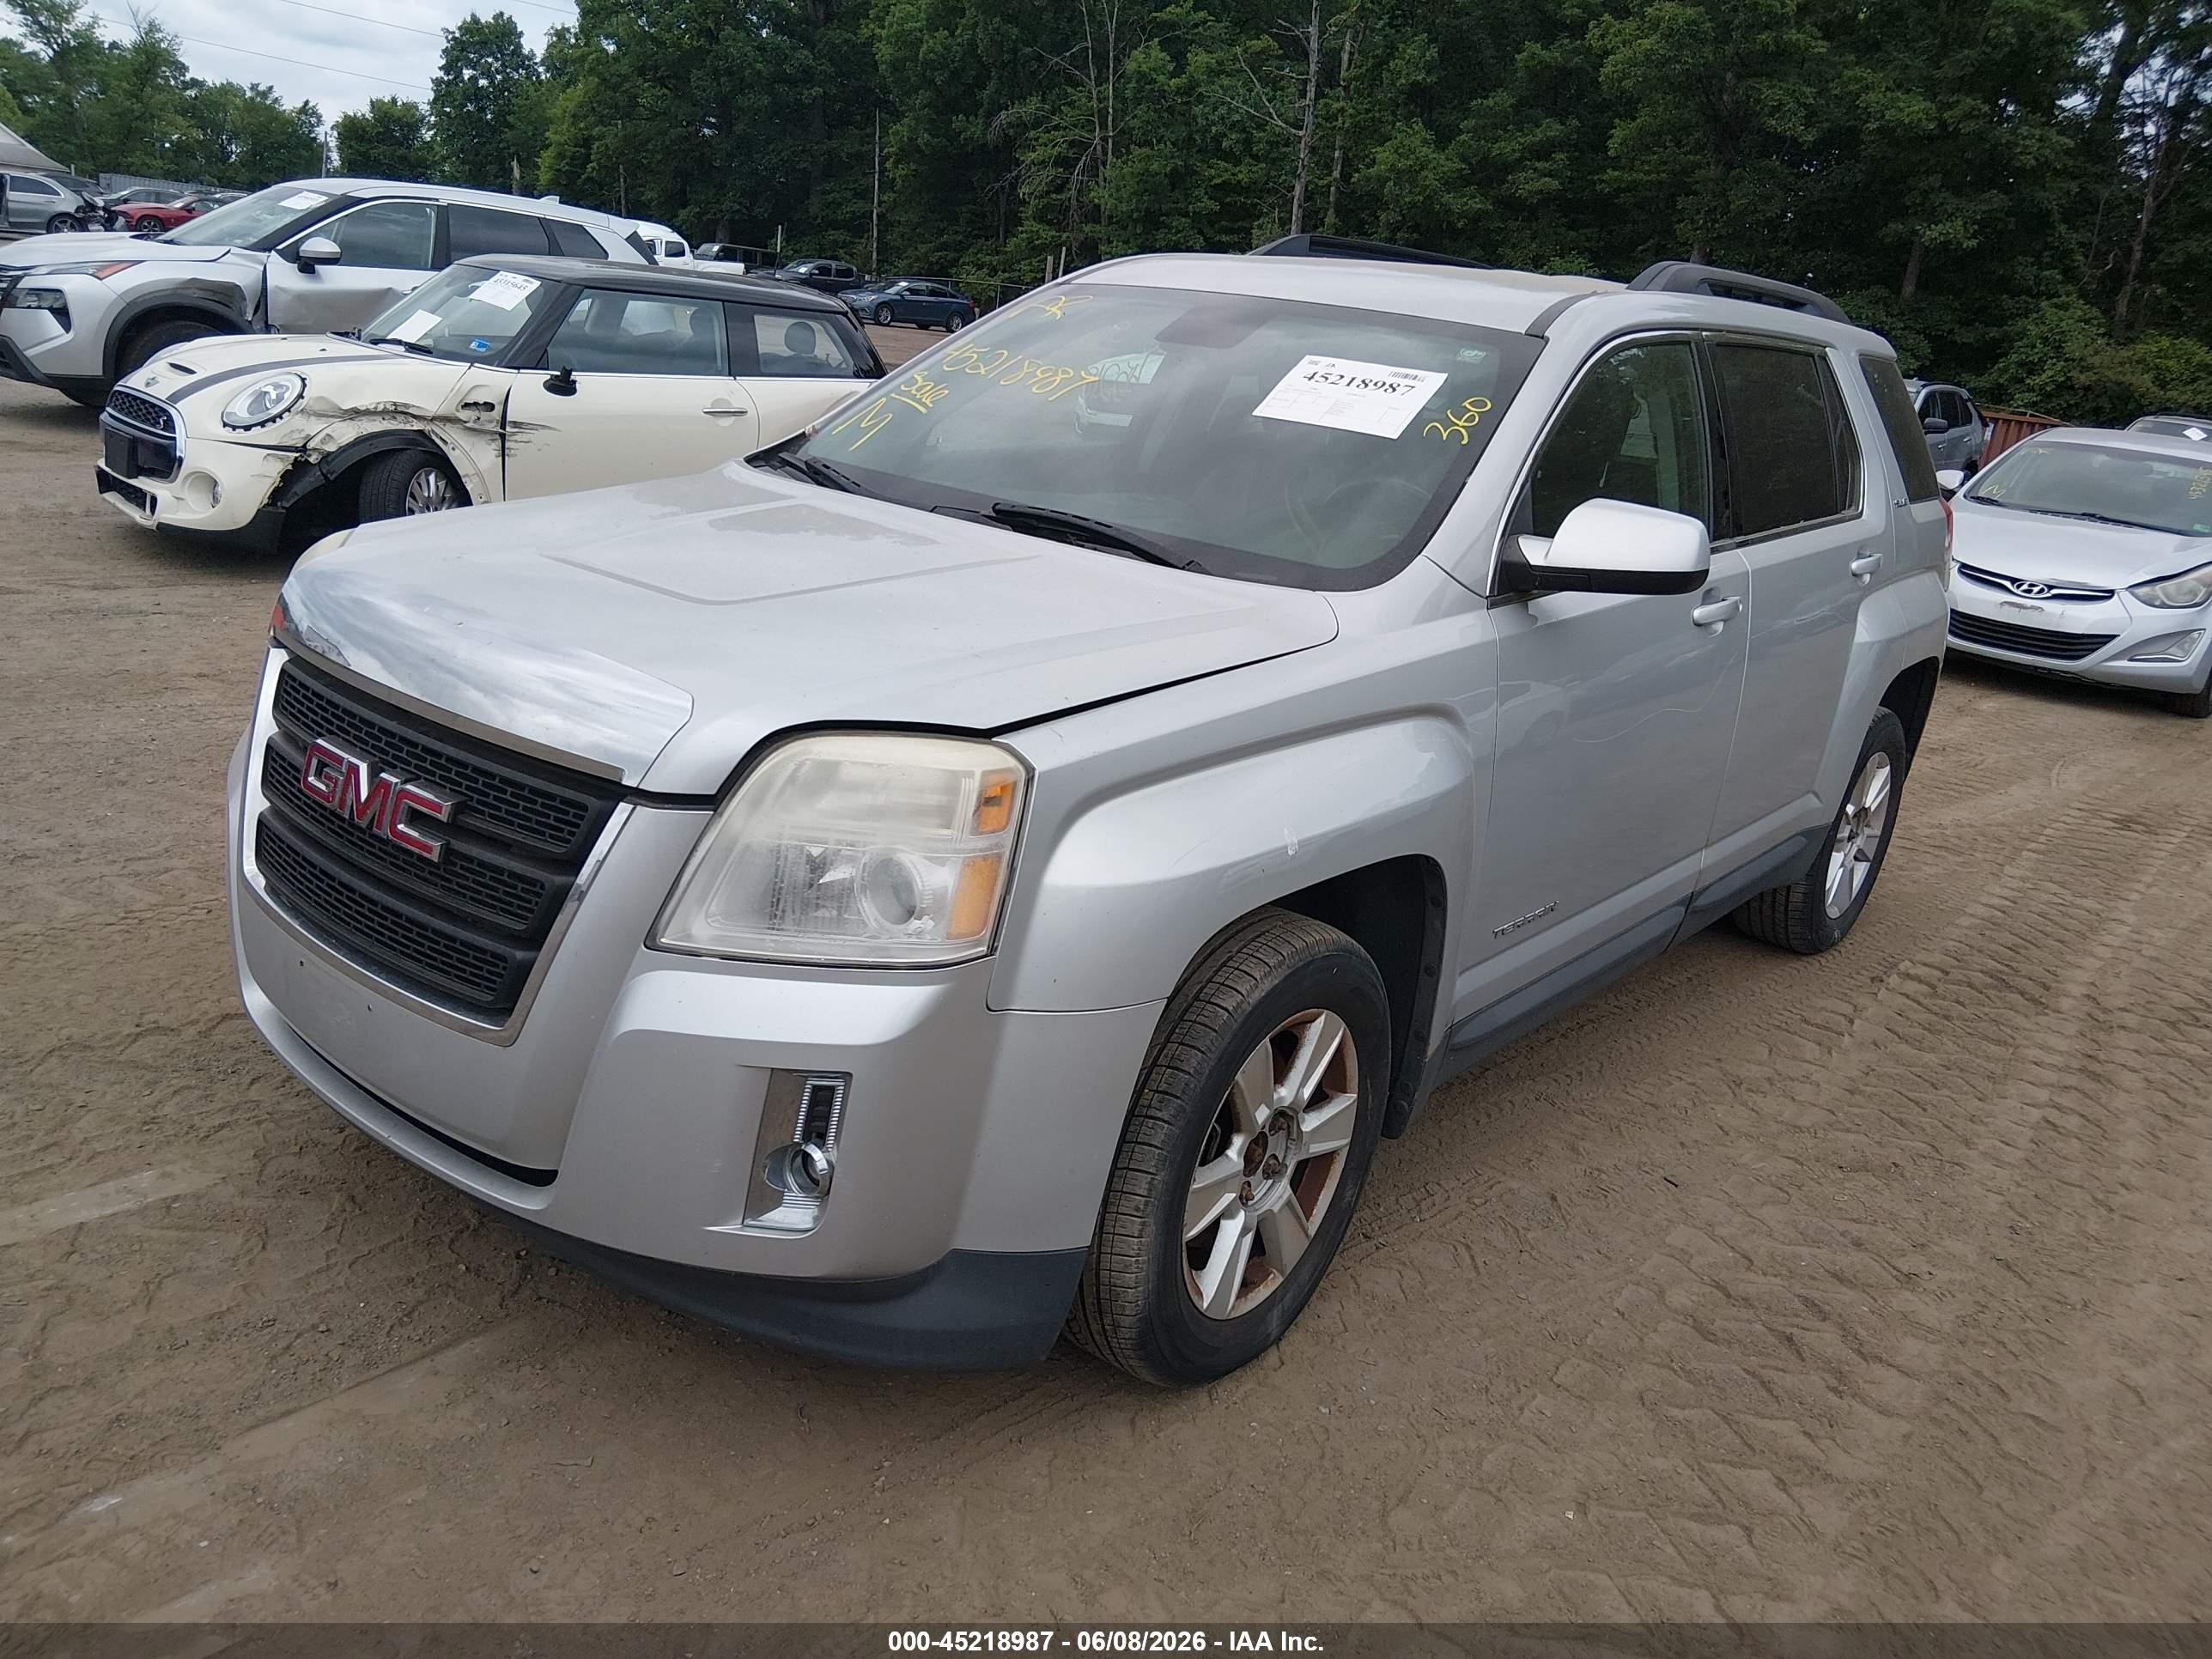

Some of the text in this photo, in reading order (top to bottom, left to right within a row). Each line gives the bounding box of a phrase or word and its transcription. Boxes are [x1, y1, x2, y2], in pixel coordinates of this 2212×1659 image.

[1303, 370, 1416, 396] 45218987
[1423, 397, 1492, 445] 360
[301, 738, 455, 863] GMC
